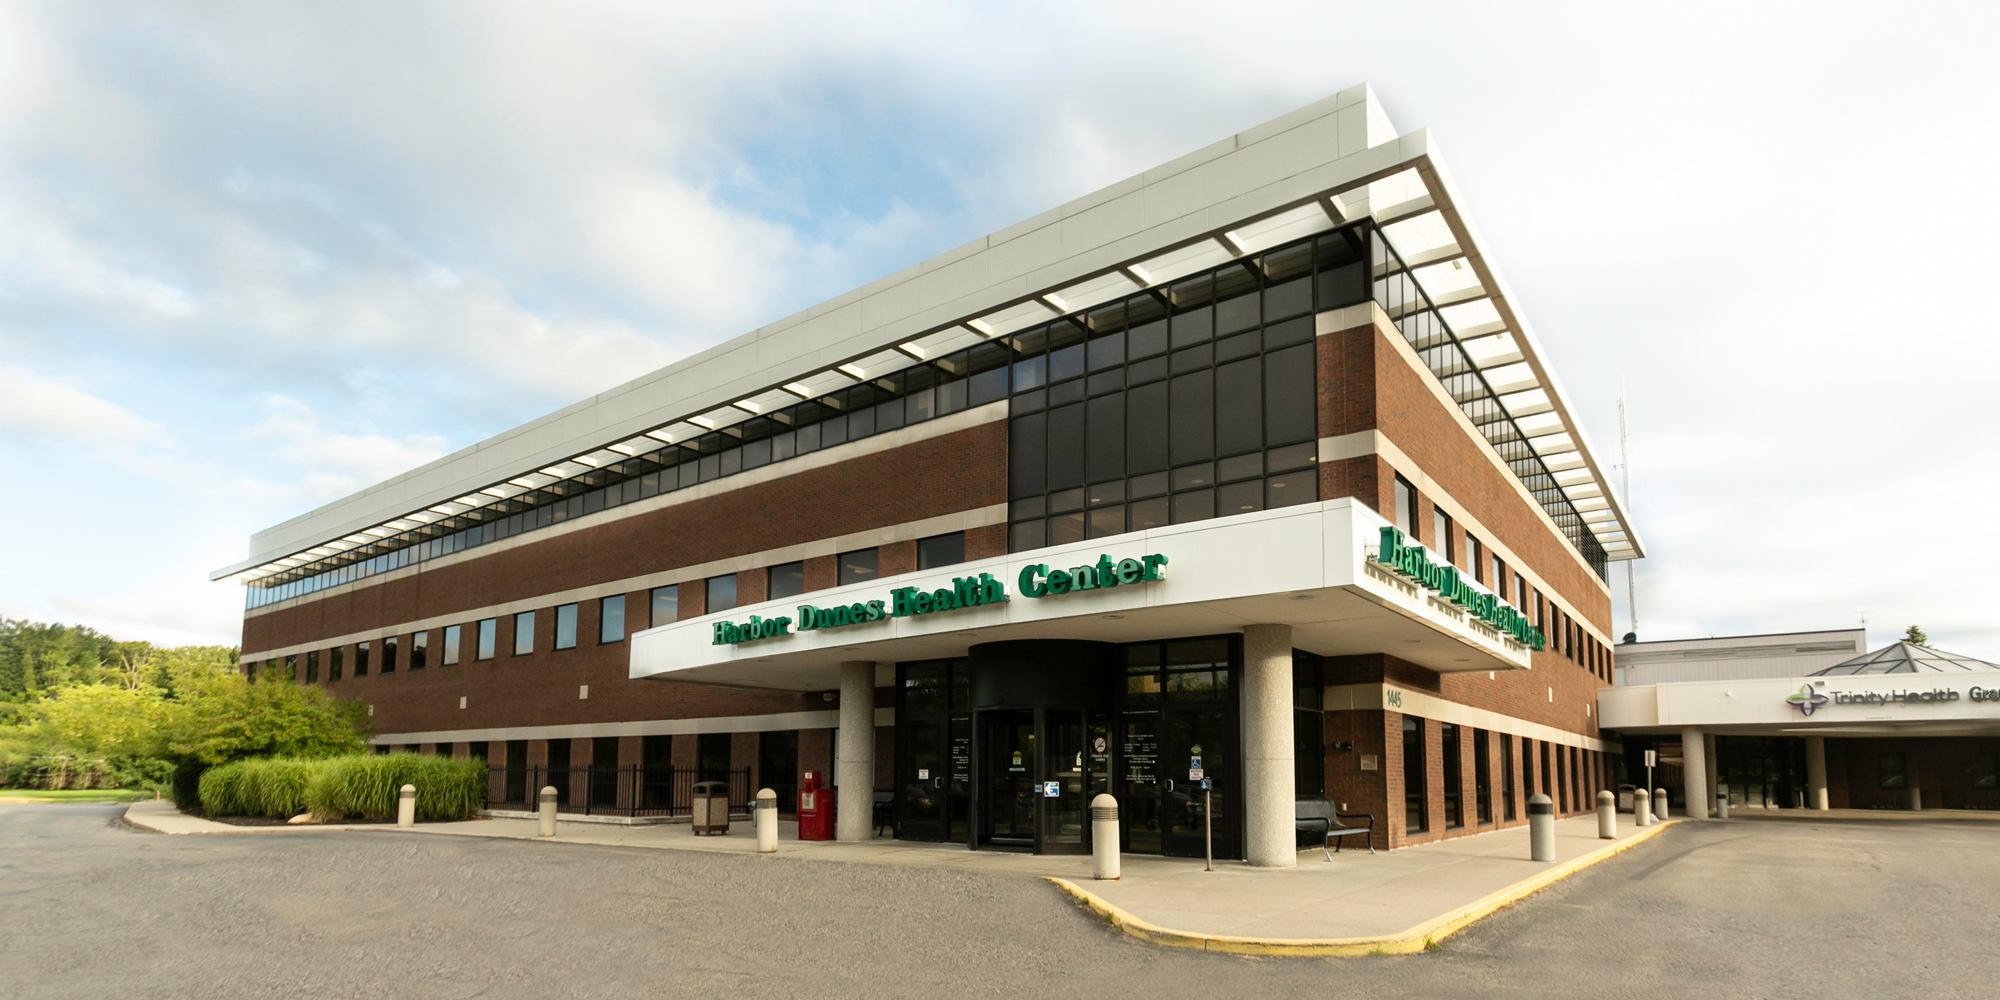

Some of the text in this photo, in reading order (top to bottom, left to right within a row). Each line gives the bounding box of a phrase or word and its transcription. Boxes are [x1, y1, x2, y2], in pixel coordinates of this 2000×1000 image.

[712, 553, 1168, 645] Harbor Dunes Health Center
[1378, 526, 1446, 593] Harbor
[1440, 566, 1487, 617] Dunes
[1386, 688, 1402, 708] 1445
[1830, 686, 2000, 706] Trinity Health Gra
